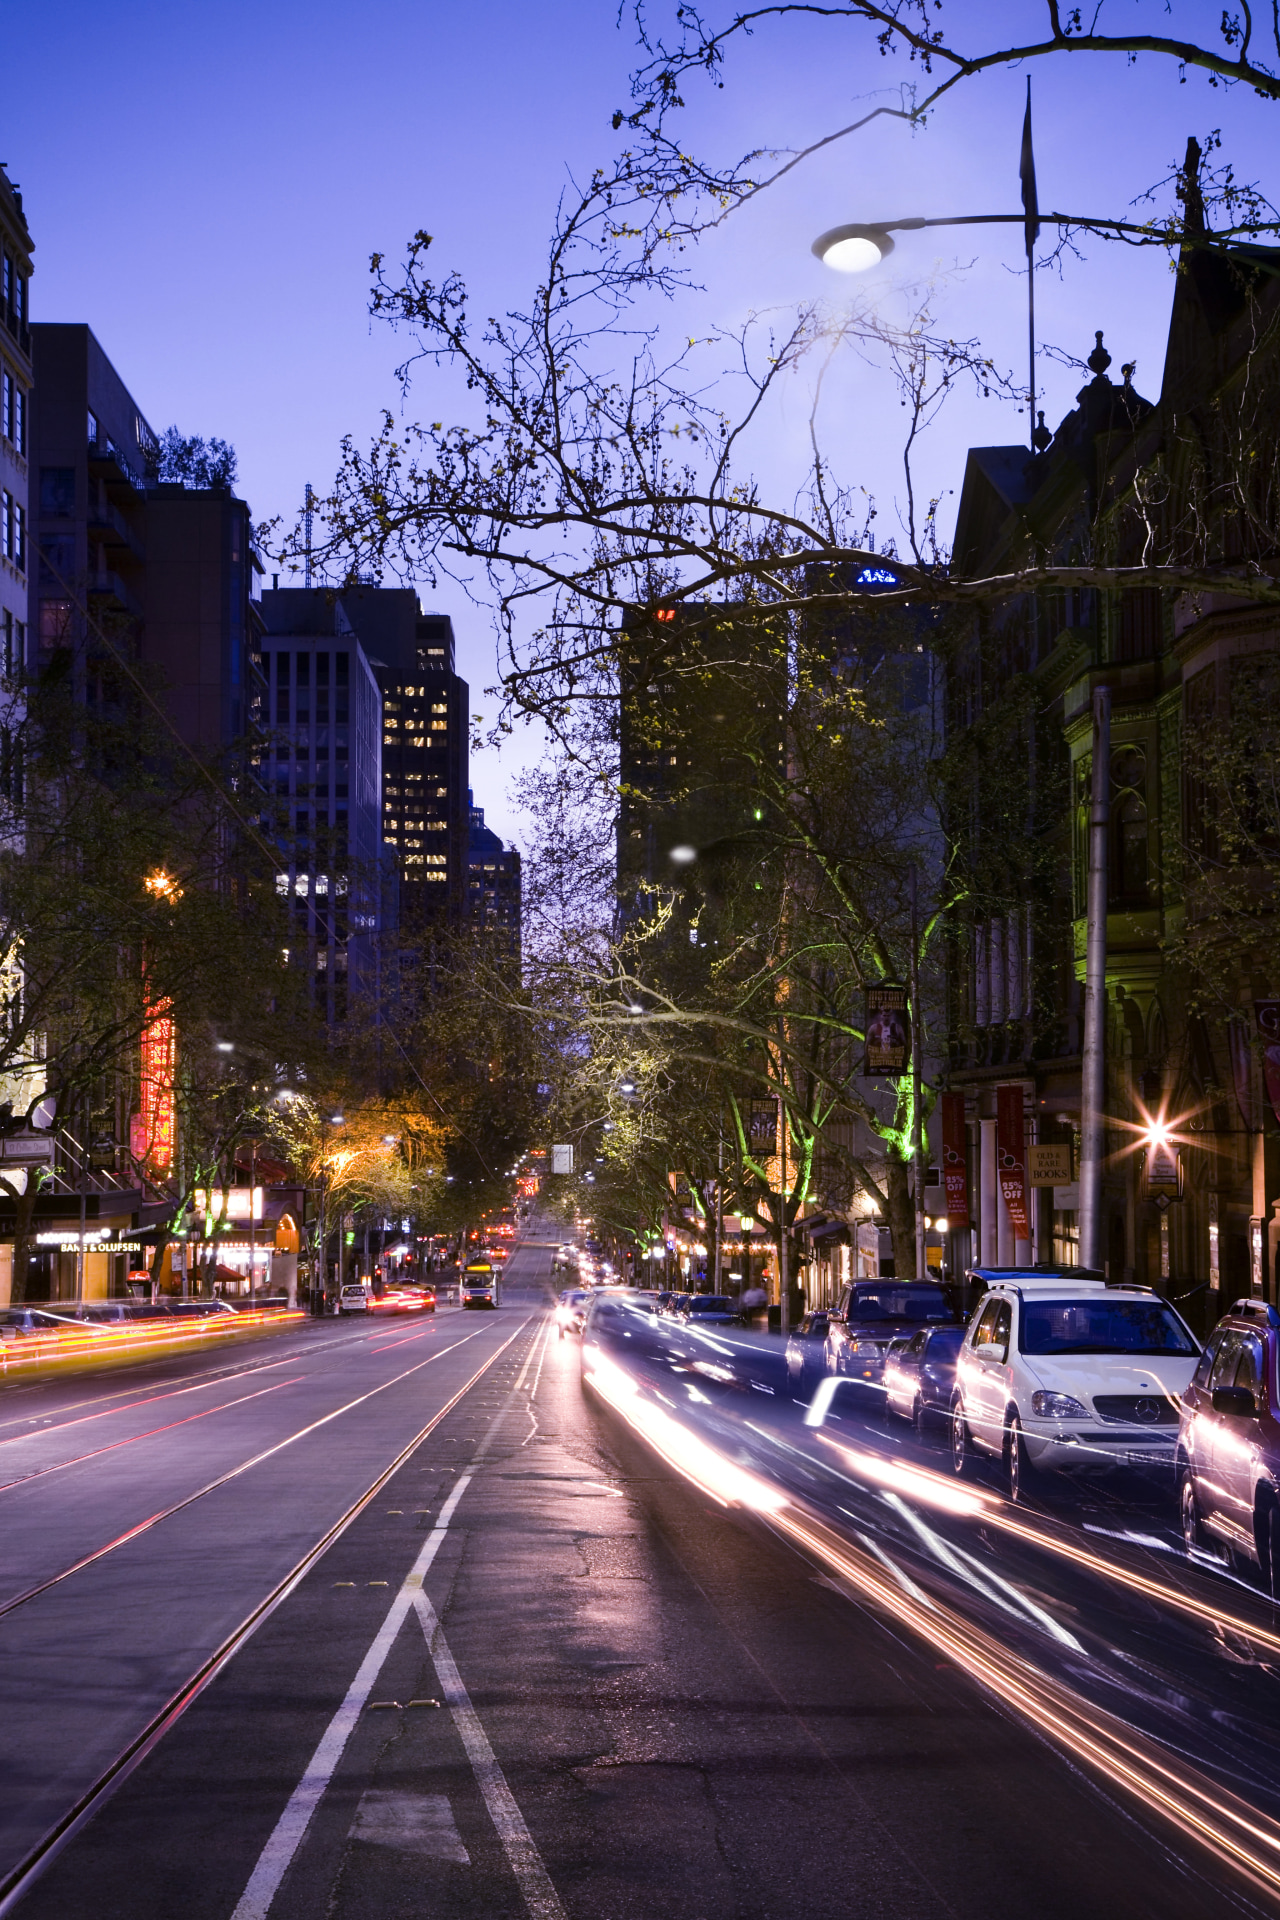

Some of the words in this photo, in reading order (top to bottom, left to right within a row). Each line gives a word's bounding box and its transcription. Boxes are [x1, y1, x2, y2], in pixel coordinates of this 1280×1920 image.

[868, 990, 906, 1001] HISTORY
[1033, 1169, 1068, 1179] BOOKS
[945, 1175, 964, 1184] 25%
[947, 1183, 963, 1191] OFF
[1002, 1181, 1023, 1190] 25%
[1003, 1190, 1022, 1199] OFF
[90, 1243, 97, 1252] &
[97, 1242, 141, 1252] OLUFSEN
